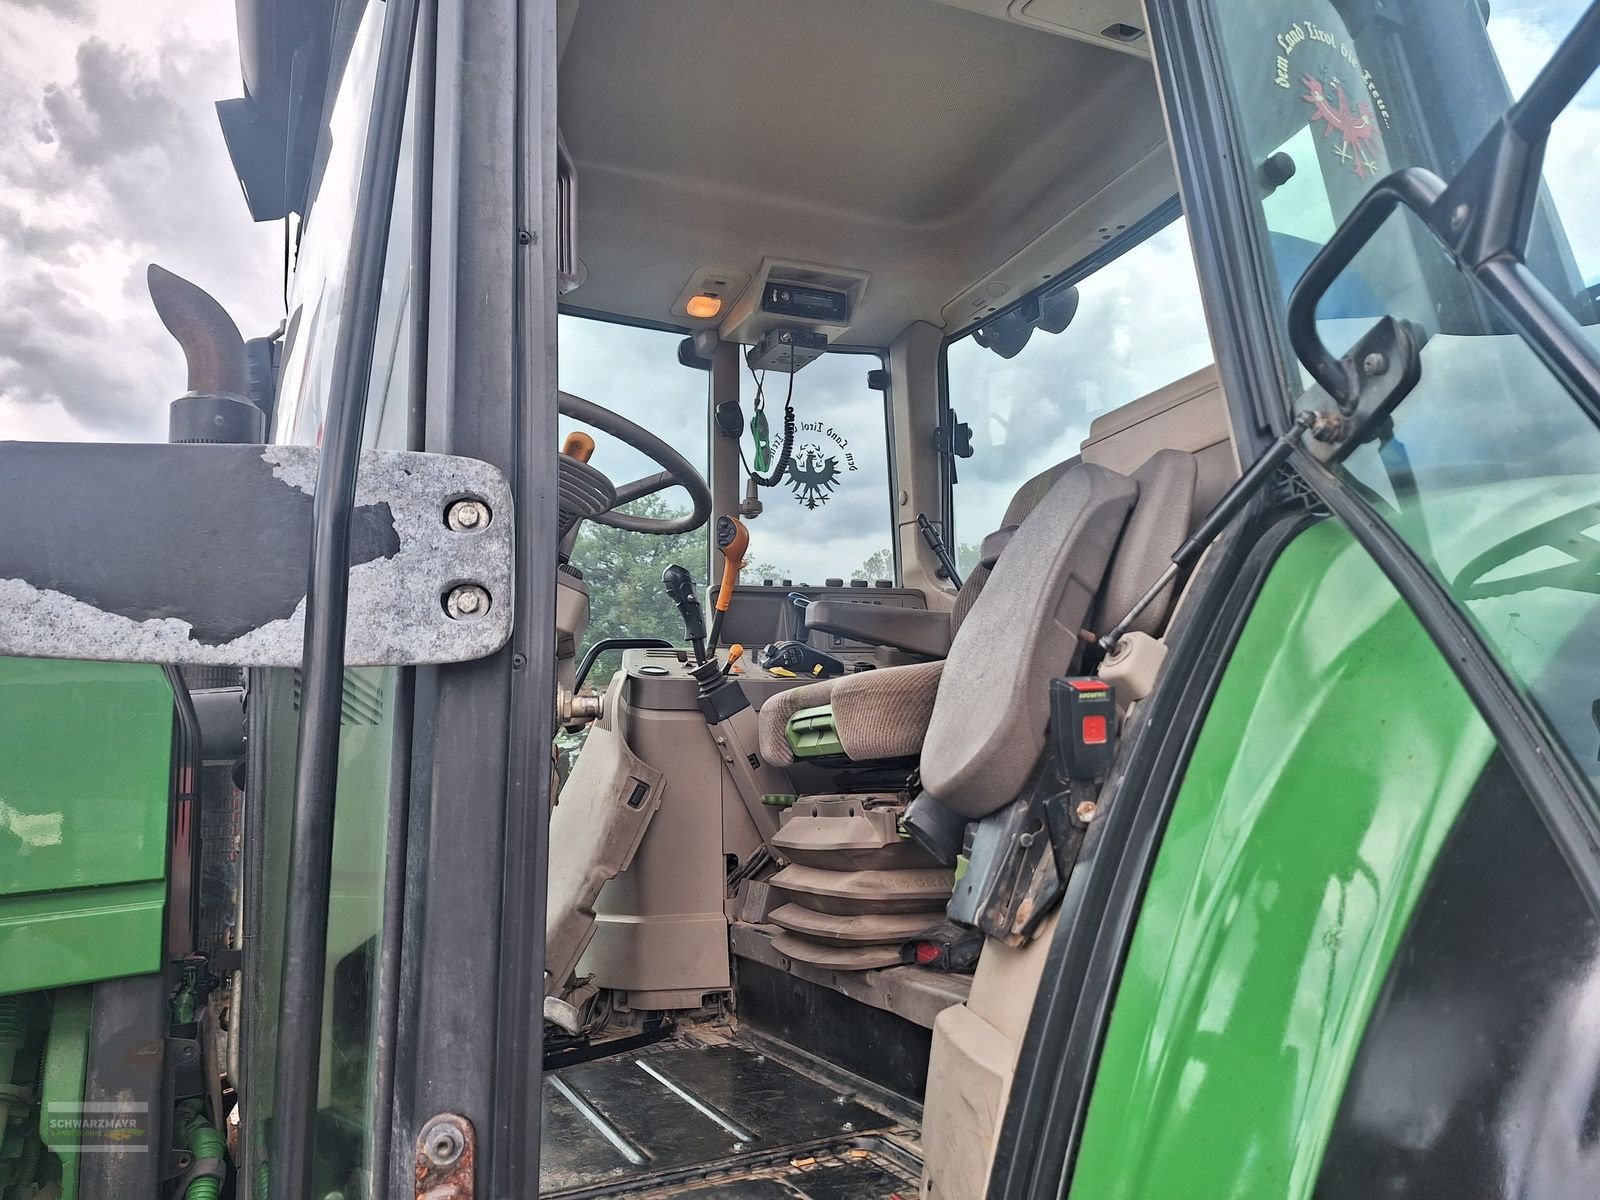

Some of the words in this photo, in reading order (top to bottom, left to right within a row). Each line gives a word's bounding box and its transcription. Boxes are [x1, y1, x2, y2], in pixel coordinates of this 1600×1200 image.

[1277, 23, 1305, 55] Land
[1304, 21, 1337, 49] Tirol
[1274, 55, 1290, 89] dem
